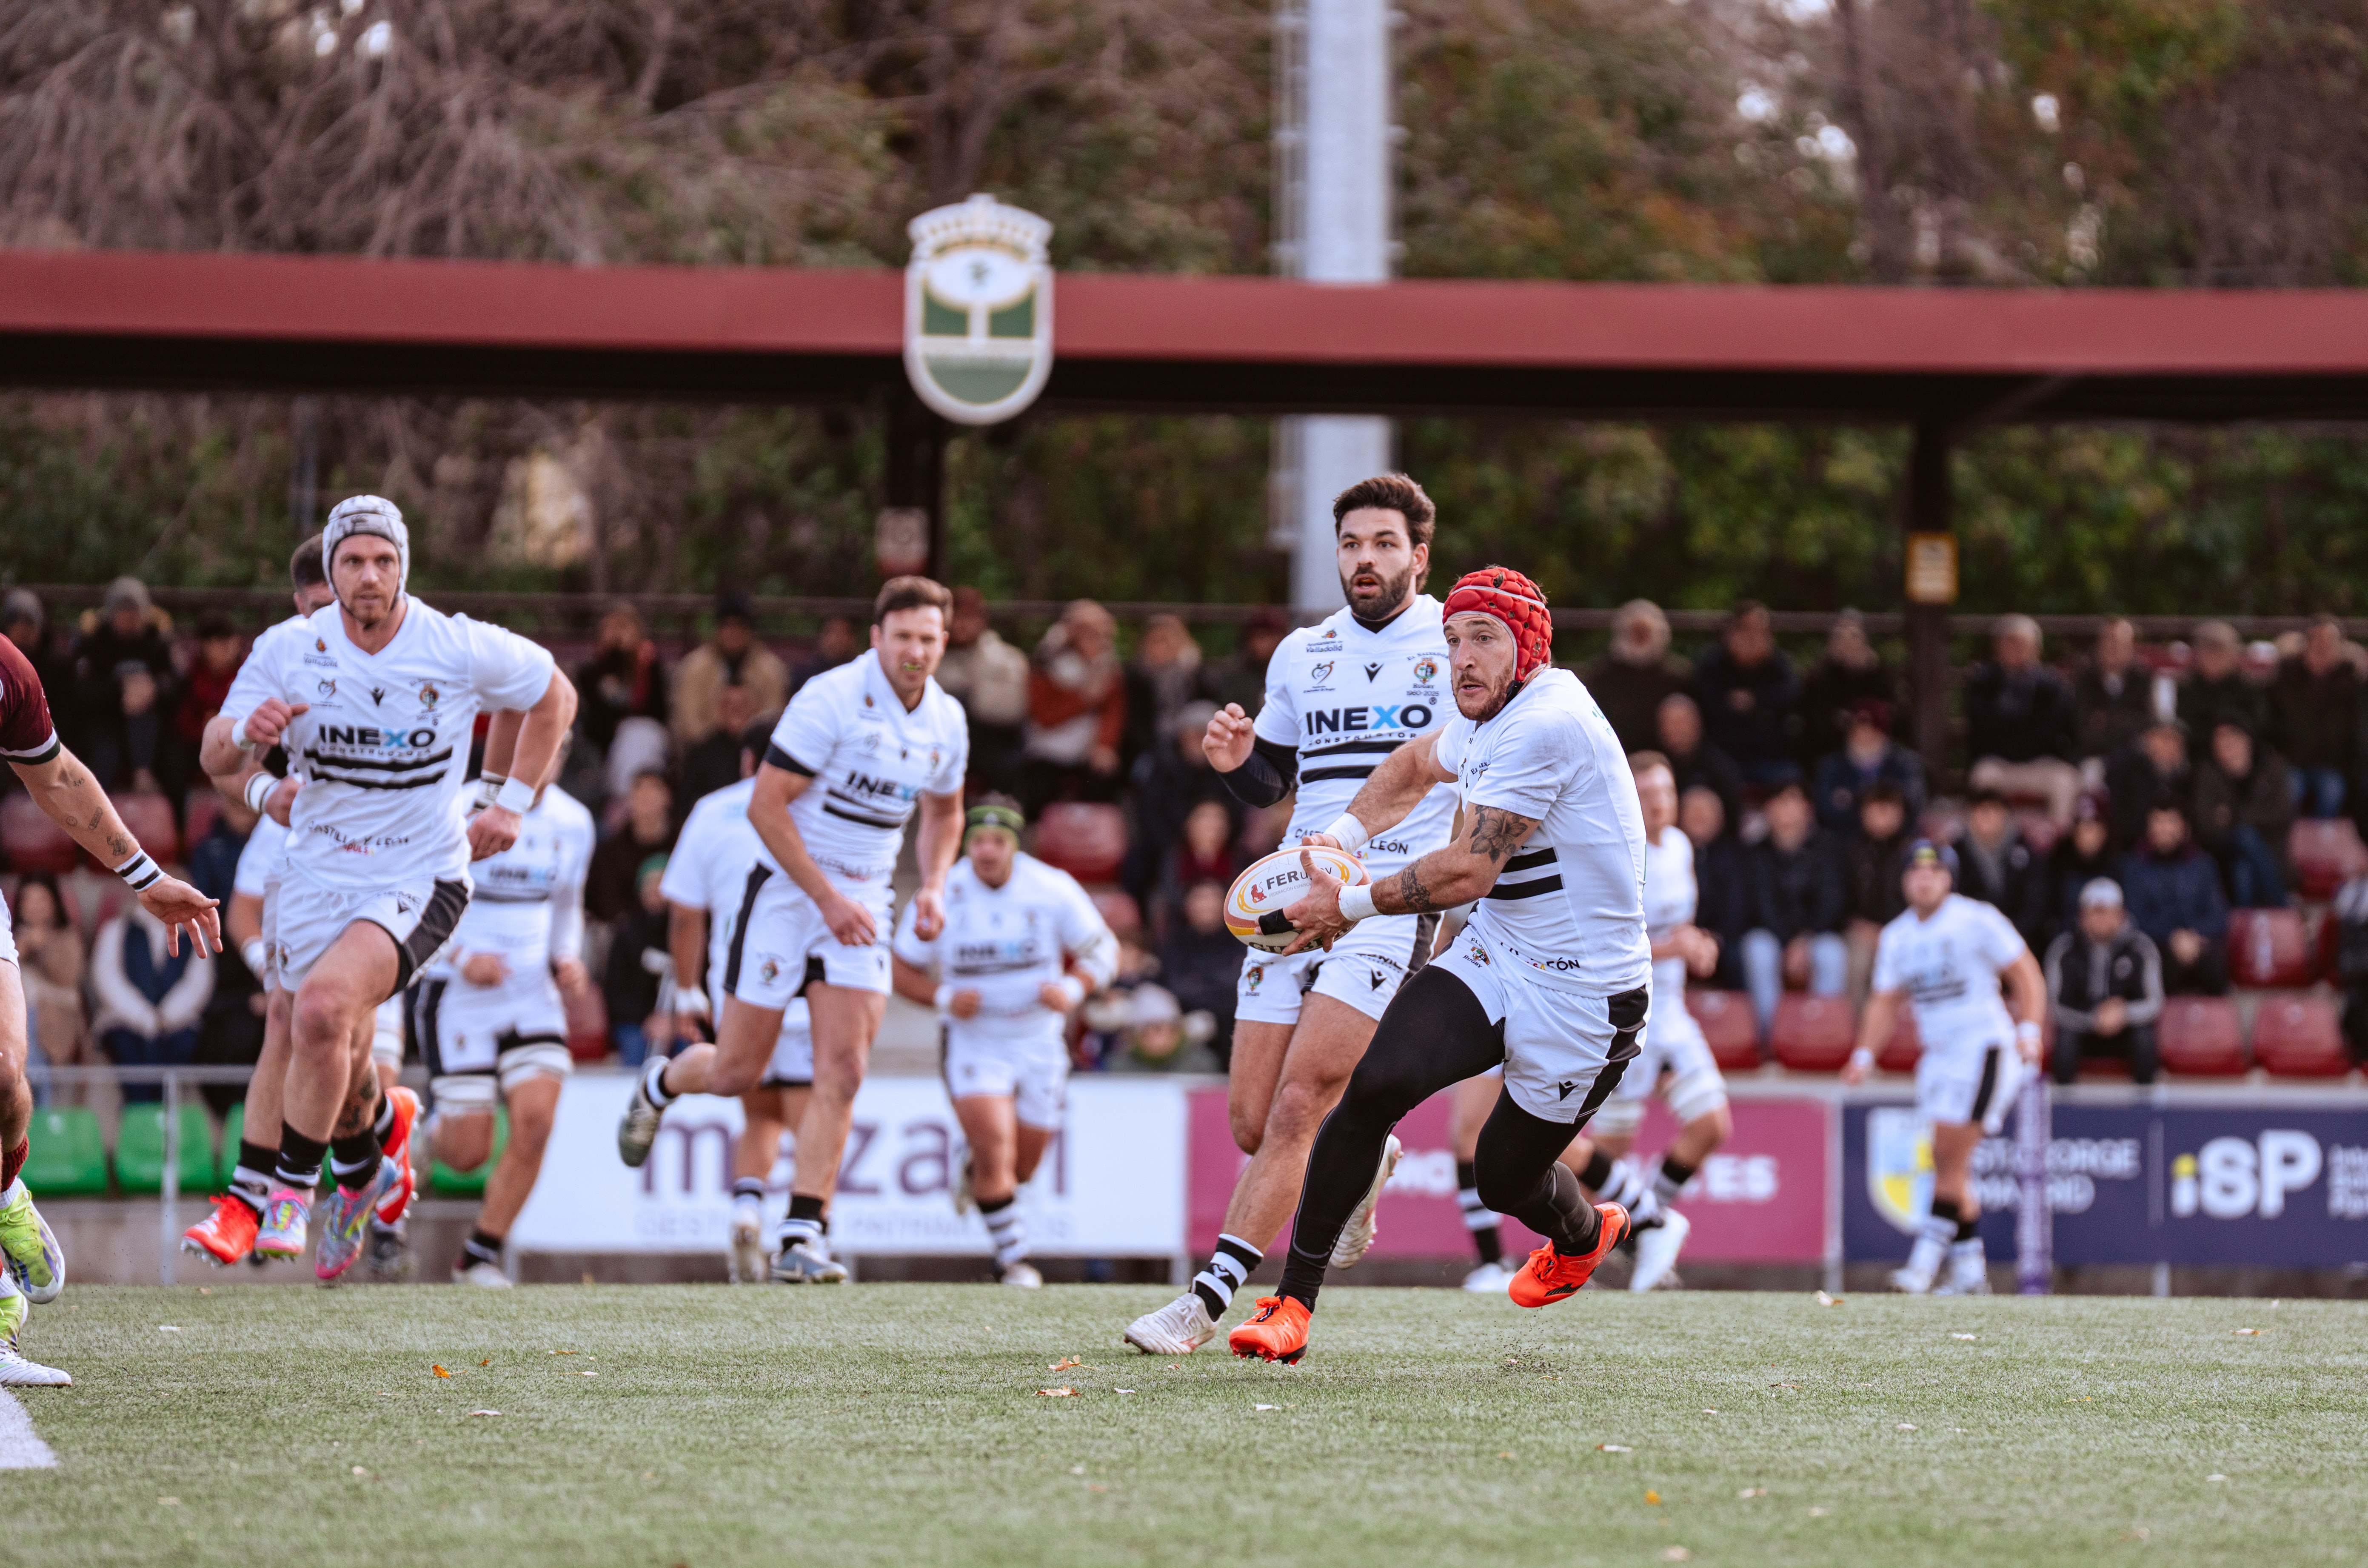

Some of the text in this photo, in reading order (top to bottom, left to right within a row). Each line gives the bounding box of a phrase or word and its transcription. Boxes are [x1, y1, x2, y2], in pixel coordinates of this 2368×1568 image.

[1306, 644, 1343, 653] Valladolid
[1306, 704, 1432, 736] INEXO
[319, 724, 436, 747] INEXO
[1369, 838, 1408, 855] LEÓN
[1269, 886, 1294, 898] FEDERACIÓN
[1462, 955, 1483, 968] RUGBY
